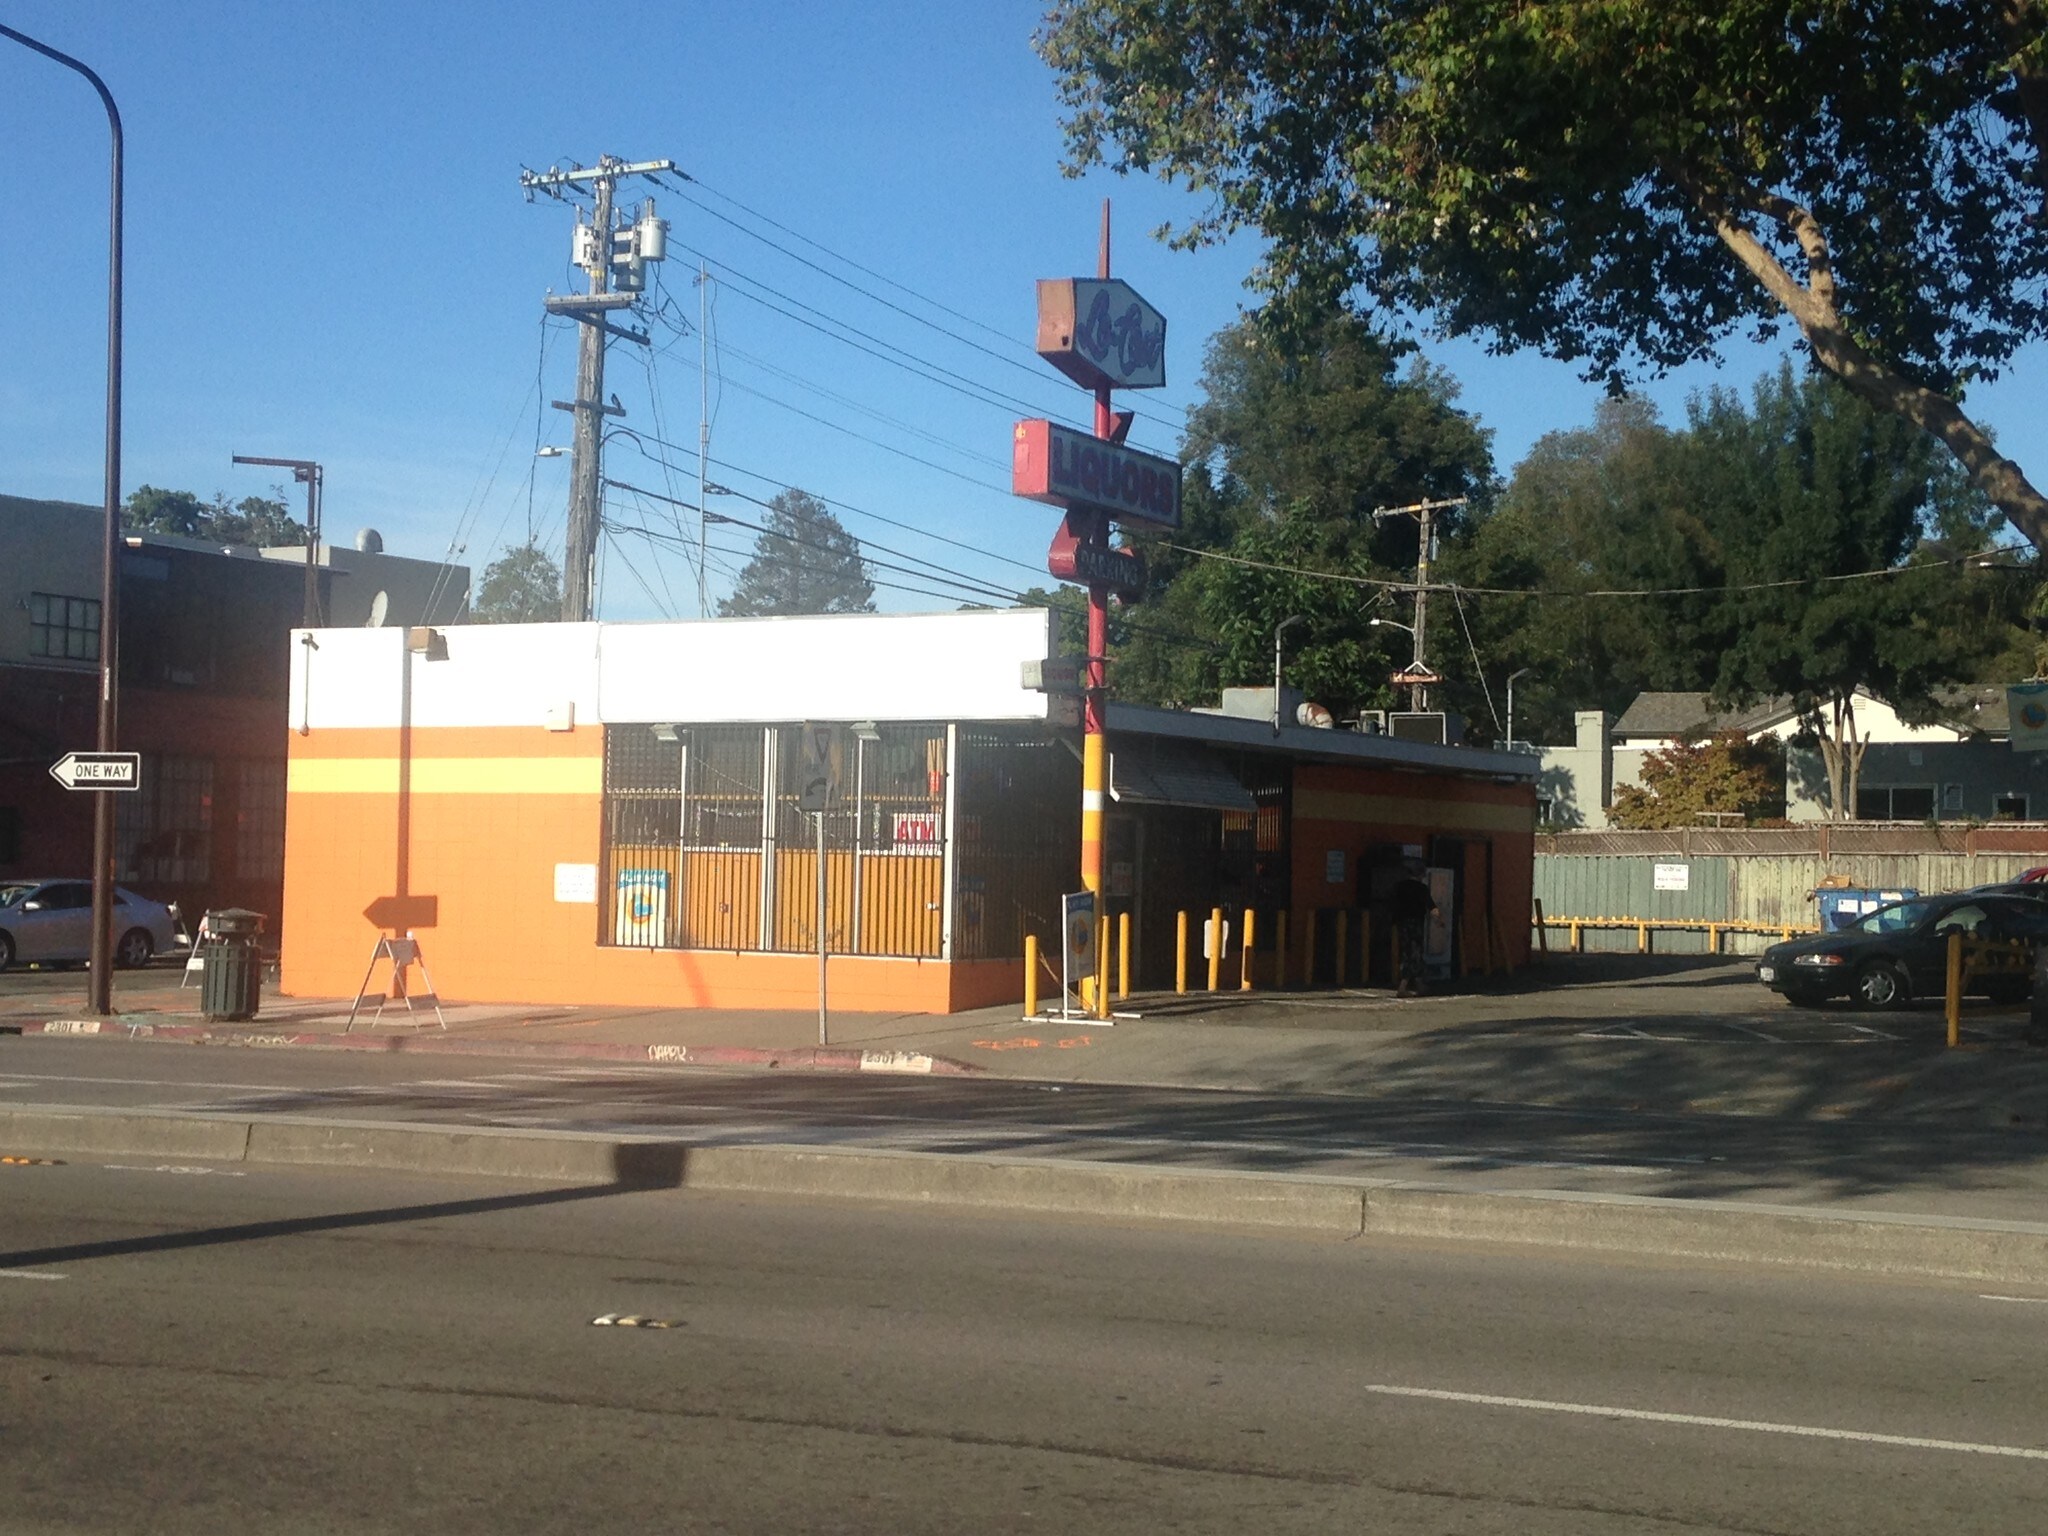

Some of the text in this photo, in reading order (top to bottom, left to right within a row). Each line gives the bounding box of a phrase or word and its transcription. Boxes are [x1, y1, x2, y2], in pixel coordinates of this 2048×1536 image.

[1053, 436, 1174, 515] LIQUORS
[1081, 549, 1138, 586] PARKING
[76, 764, 128, 777] ONE WAY
[898, 820, 935, 844] ATM
